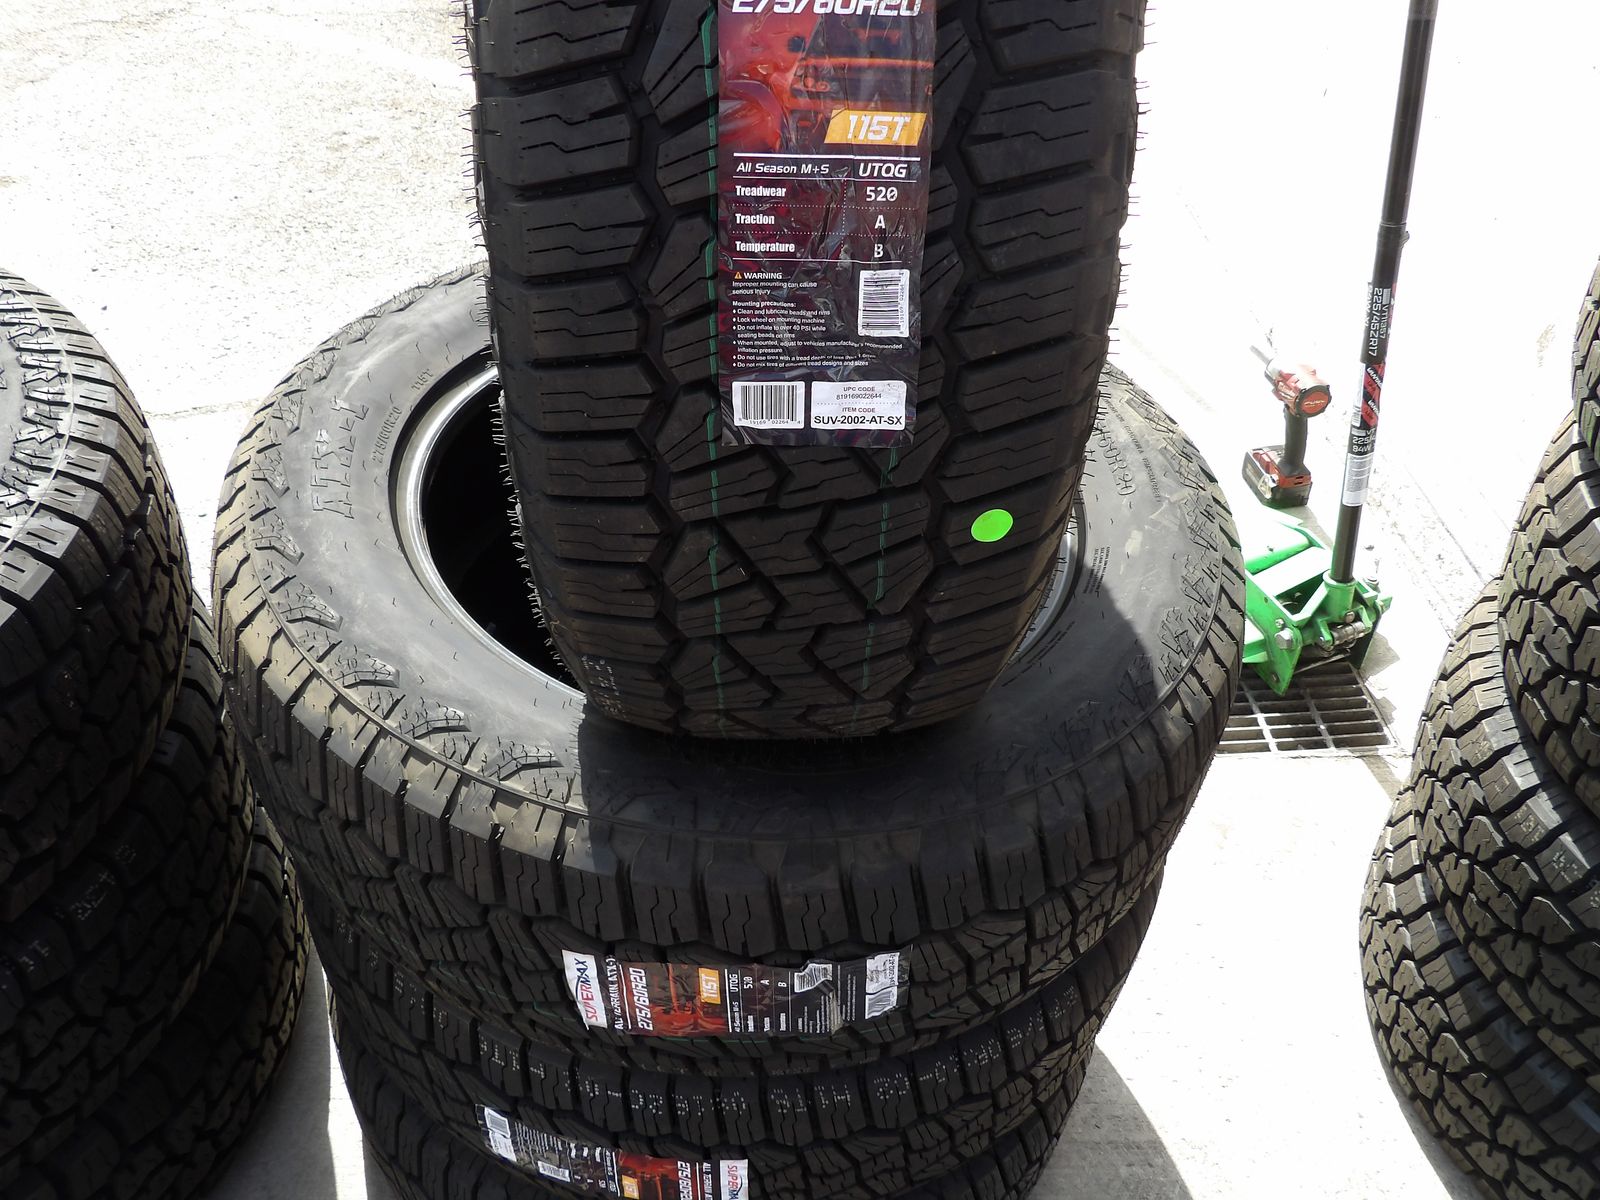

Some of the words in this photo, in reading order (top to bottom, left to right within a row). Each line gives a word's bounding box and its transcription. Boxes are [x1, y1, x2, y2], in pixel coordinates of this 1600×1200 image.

[847, 114, 911, 142] 115T
[736, 162, 752, 174] All
[755, 162, 797, 174] Season
[801, 163, 830, 174] M+S
[858, 163, 908, 178] UTQG
[735, 185, 787, 198] Treadwear
[866, 187, 898, 202] 520
[735, 213, 775, 225] Traction
[874, 214, 886, 230] A
[735, 241, 796, 253] Temperature
[873, 243, 884, 258] B
[743, 272, 782, 280] WARNING
[1368, 287, 1384, 358] 225/45ZR17
[813, 415, 903, 426] SUV-2002-AT-SX
[629, 966, 654, 1031] 275/60R20
[677, 1160, 691, 1200] 275/60R2
